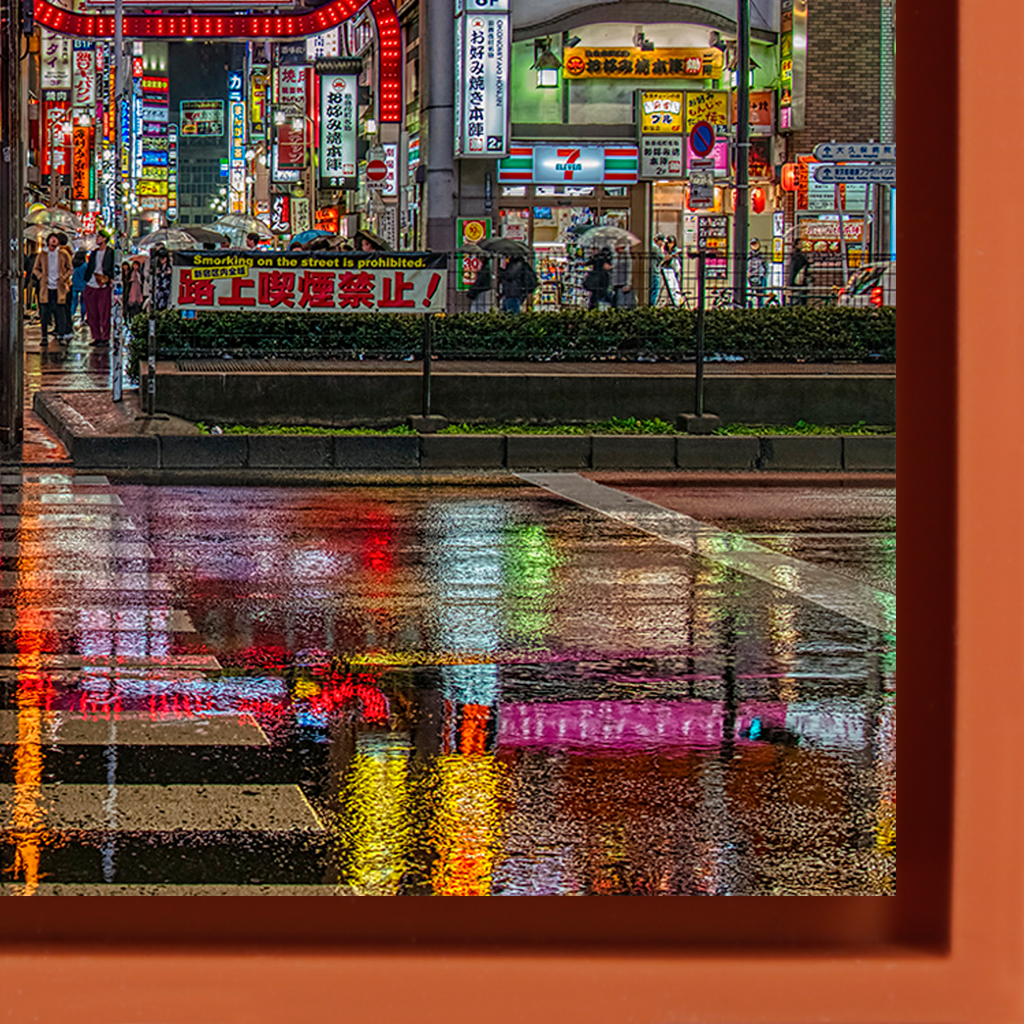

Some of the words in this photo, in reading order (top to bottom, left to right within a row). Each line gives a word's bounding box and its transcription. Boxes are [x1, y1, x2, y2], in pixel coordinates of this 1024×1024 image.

[468, 30, 485, 137] お好み焼き本陣
[488, 135, 502, 151] 2F
[193, 255, 254, 269] Smorking
[257, 257, 274, 267] on
[276, 256, 298, 267] the
[302, 256, 340, 268] street
[342, 256, 355, 267] is
[357, 256, 427, 270] prohibited.
